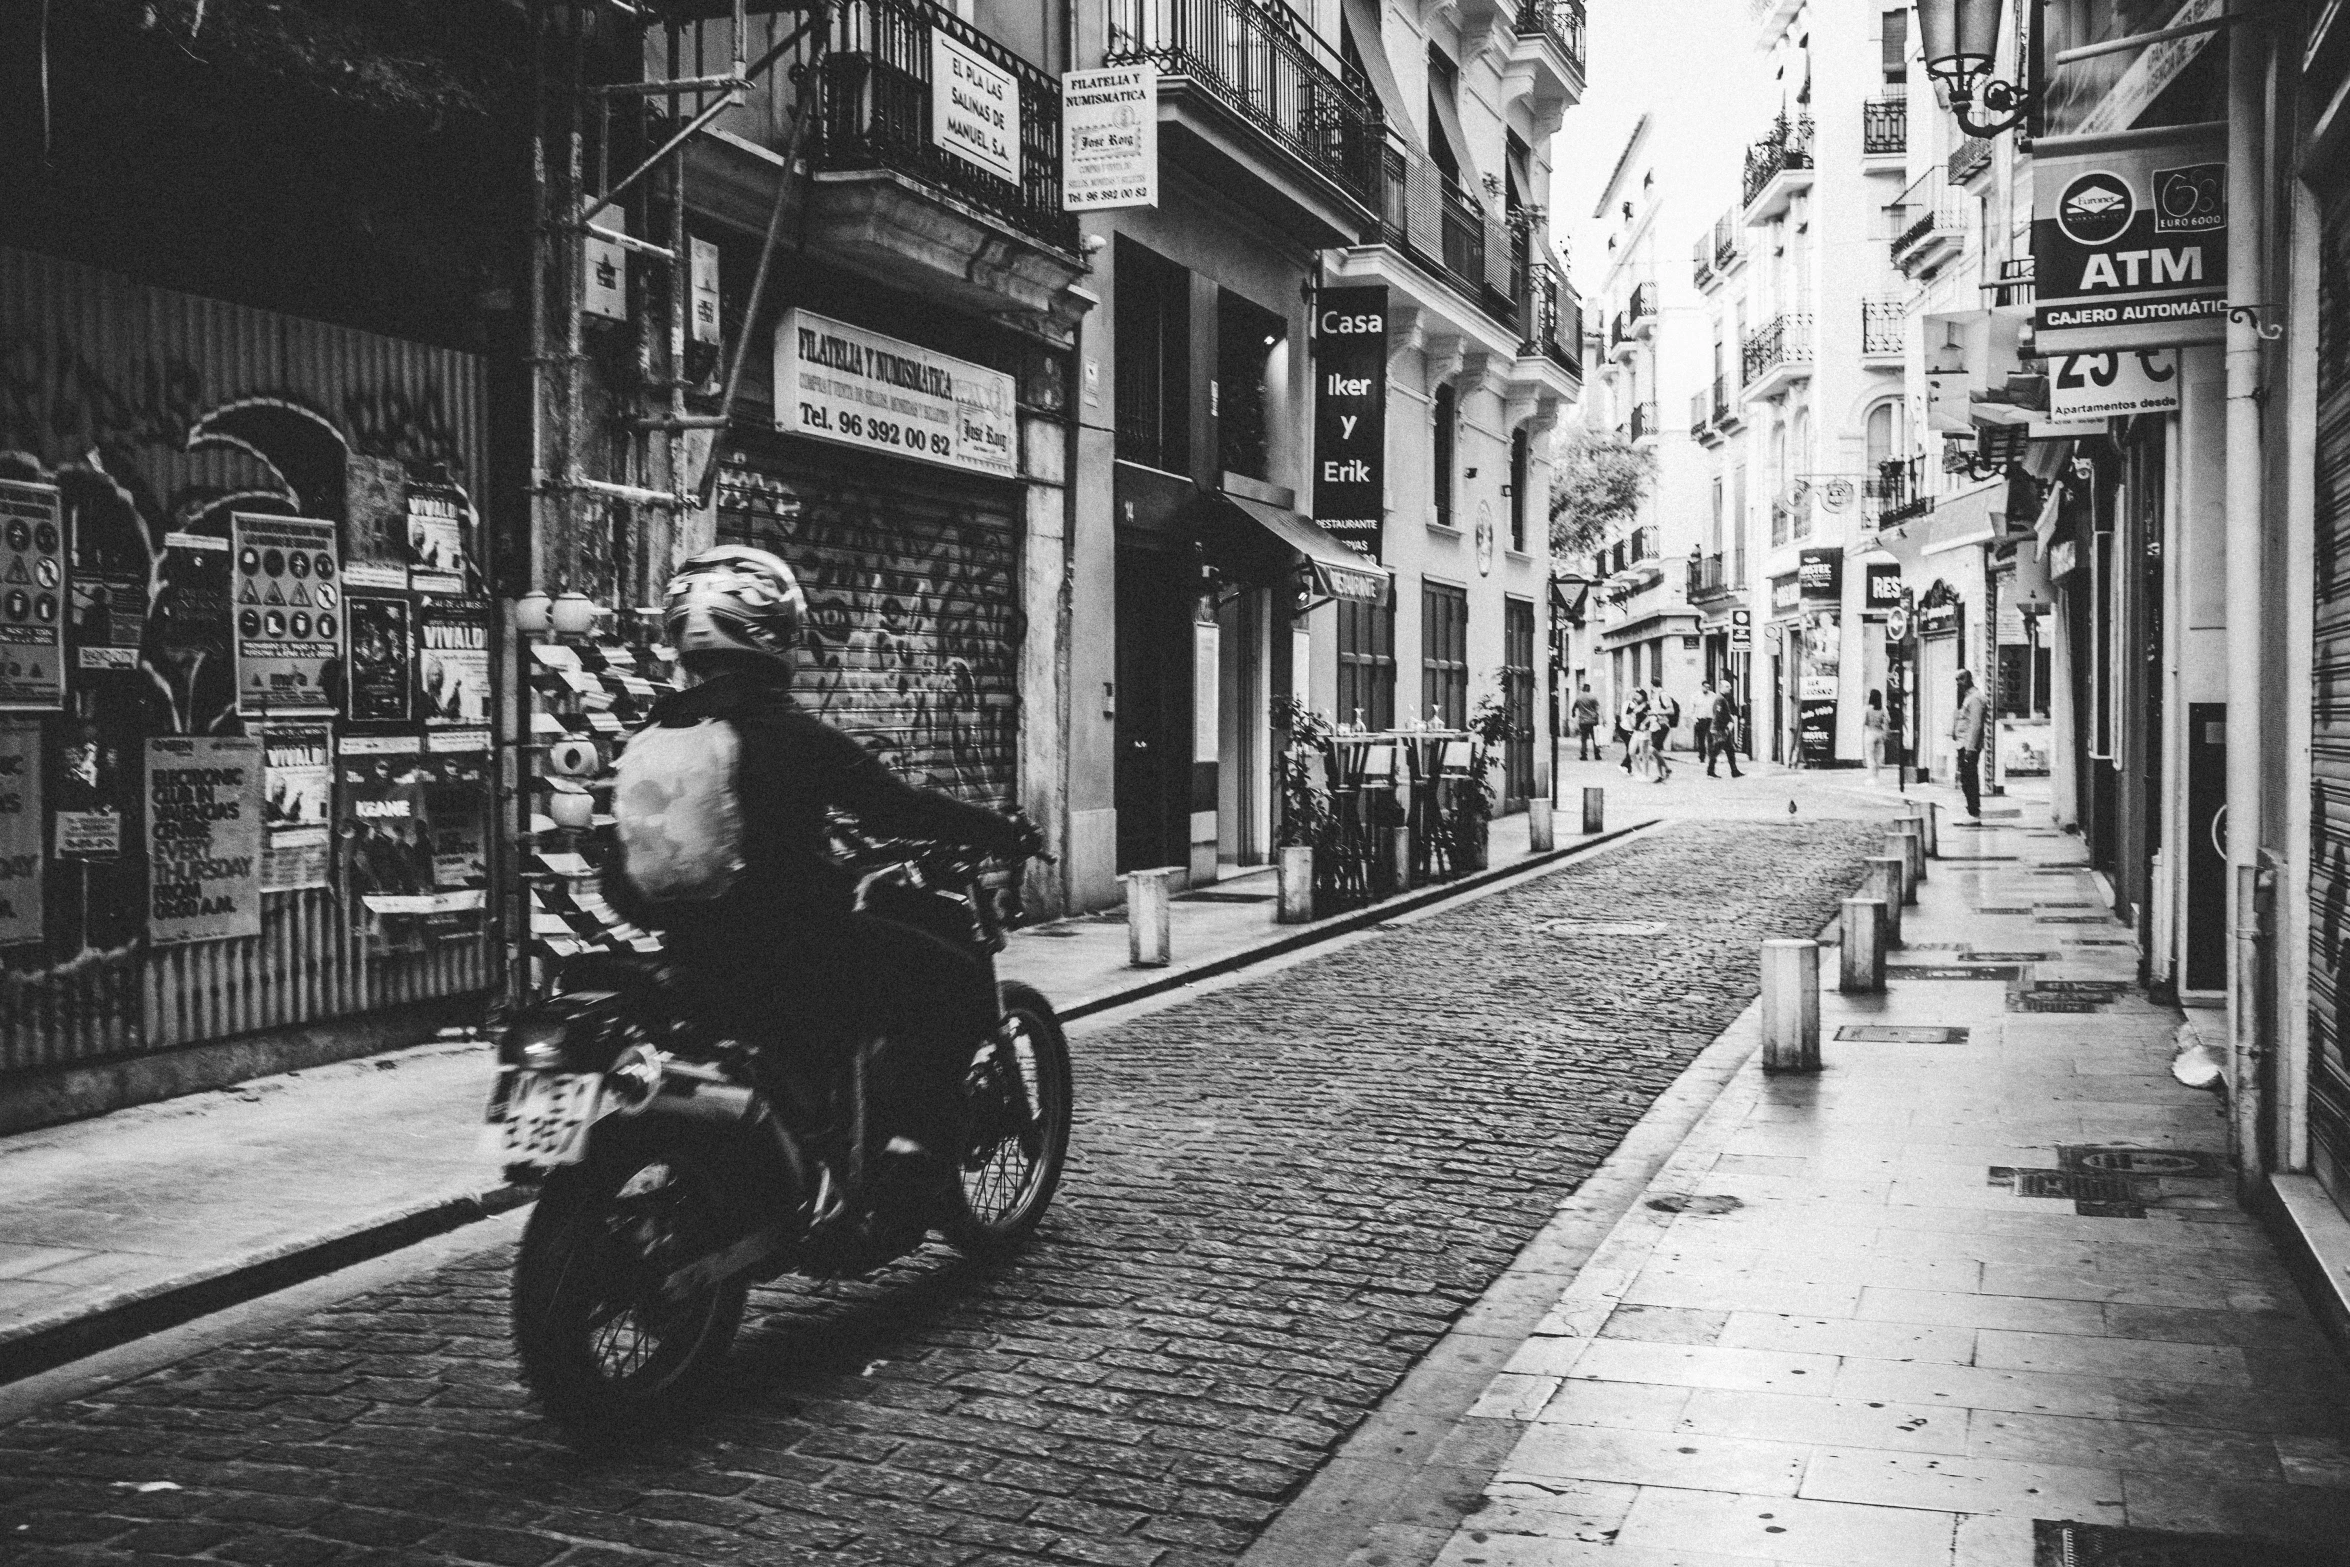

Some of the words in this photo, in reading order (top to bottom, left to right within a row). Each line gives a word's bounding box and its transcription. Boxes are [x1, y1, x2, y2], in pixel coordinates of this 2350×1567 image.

[952, 57, 964, 79] EL
[966, 63, 983, 90] PLA
[986, 79, 1003, 101] LAS
[1071, 74, 1130, 90] FILATELIA
[1133, 73, 1141, 84] Y
[951, 86, 990, 121] SALINAS
[993, 110, 1005, 130] DE
[1108, 134, 1134, 147] Roig
[1067, 192, 1083, 203] Tel.
[1086, 190, 1098, 202] 96
[1100, 189, 1118, 201] 392
[1121, 188, 1133, 199] 00
[1135, 186, 1147, 198] 82
[2160, 217, 2189, 228] EURO
[2191, 215, 2222, 226] 6000
[2079, 246, 2203, 290] ATM
[1321, 310, 1383, 334] Casa
[2047, 306, 2118, 326] CAJERO
[2122, 297, 2228, 319] AUTOMÁTIC
[798, 326, 864, 377] FILATELIA
[865, 346, 874, 379] Y
[1328, 373, 1372, 397] Iker
[2055, 399, 2137, 416] Apartamentos
[2140, 395, 2177, 408] desde
[799, 401, 833, 430] Tel.
[838, 410, 863, 437] 96
[867, 418, 900, 445] 392
[905, 426, 926, 451] 00
[931, 434, 951, 457] 82
[1340, 415, 1358, 440] y
[1323, 459, 1371, 483] Erik
[355, 800, 411, 817] KEANE
[154, 838, 213, 862] EVERY
[153, 856, 253, 885] THURSDAY
[153, 881, 201, 902] FROM
